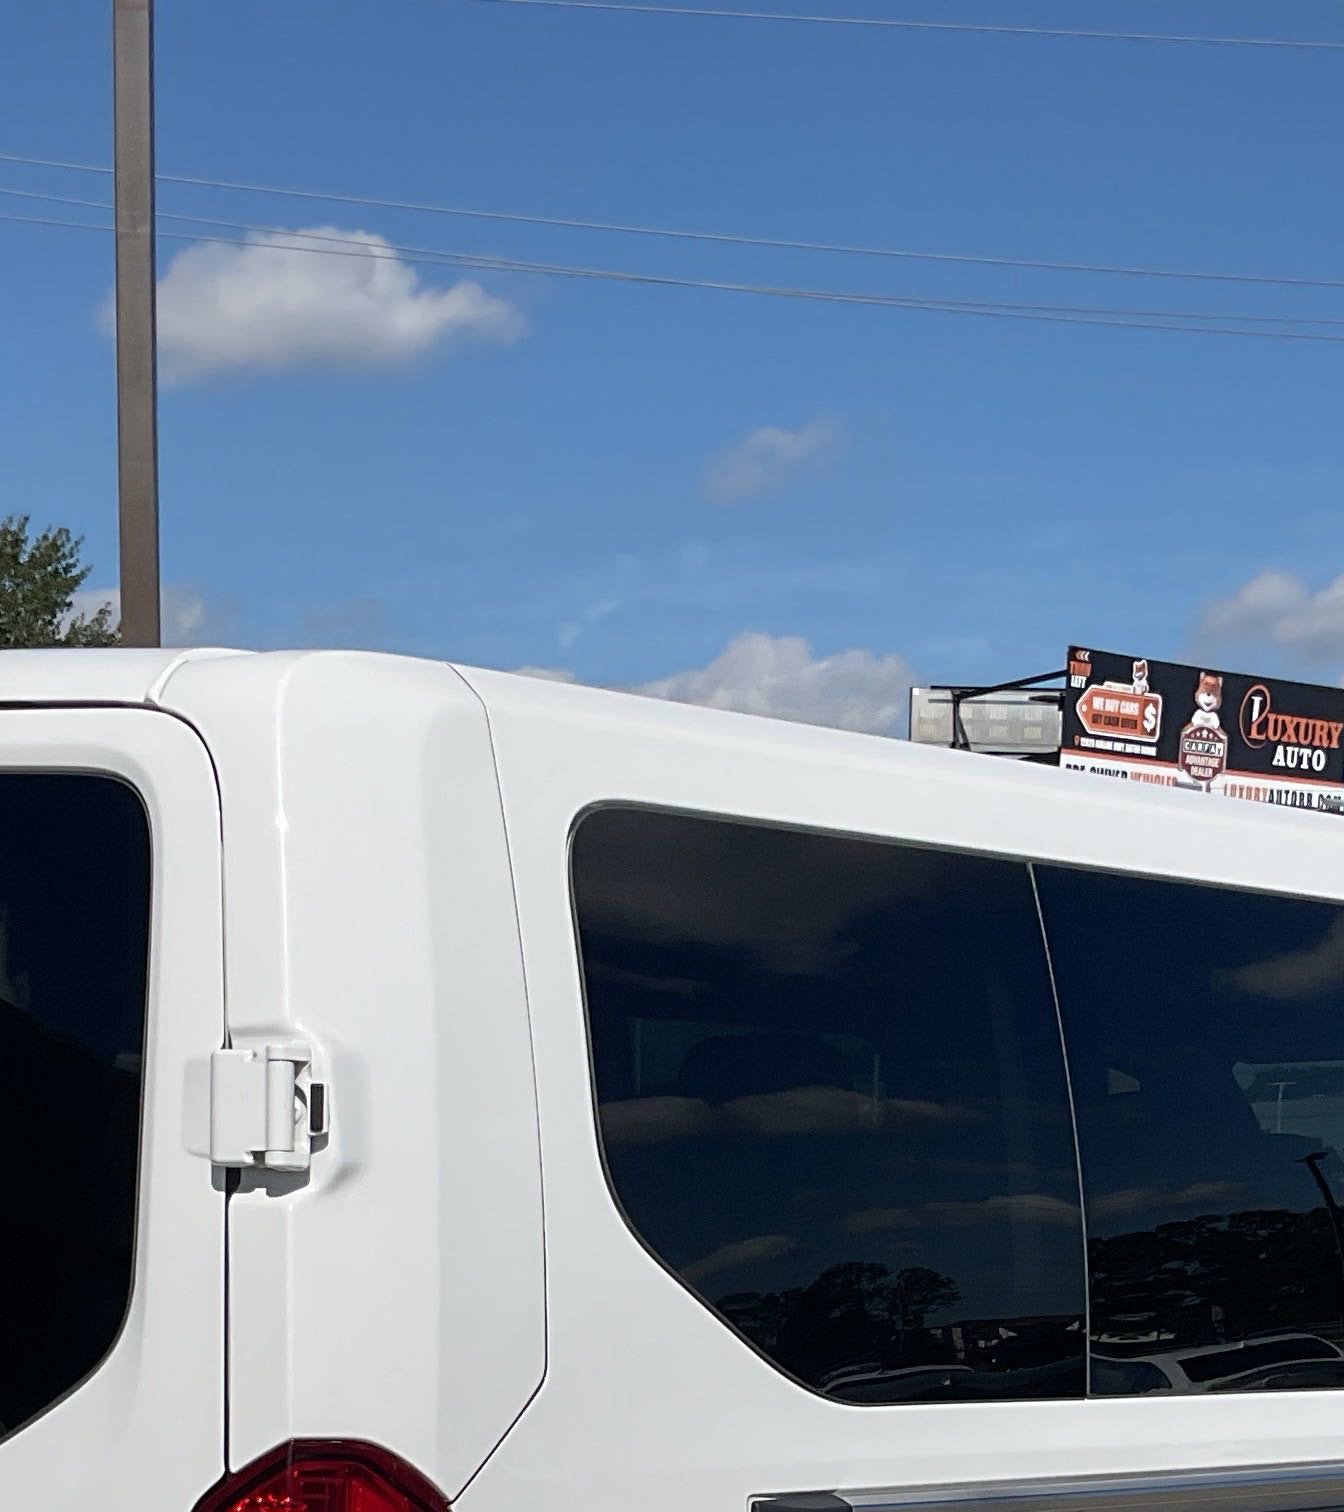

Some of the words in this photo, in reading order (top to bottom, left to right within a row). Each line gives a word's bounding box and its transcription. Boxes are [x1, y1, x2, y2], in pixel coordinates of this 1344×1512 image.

[1071, 675, 1086, 688] LEFT
[1093, 697, 1104, 711] WE
[1105, 699, 1120, 713] BUY
[1120, 701, 1139, 716] CARS
[1248, 696, 1344, 749] LUXURY
[1185, 741, 1223, 756] CARFAX
[1185, 755, 1220, 768] ADVANTAGE
[1272, 745, 1326, 772] AUTO
[1191, 766, 1213, 777] DEALER
